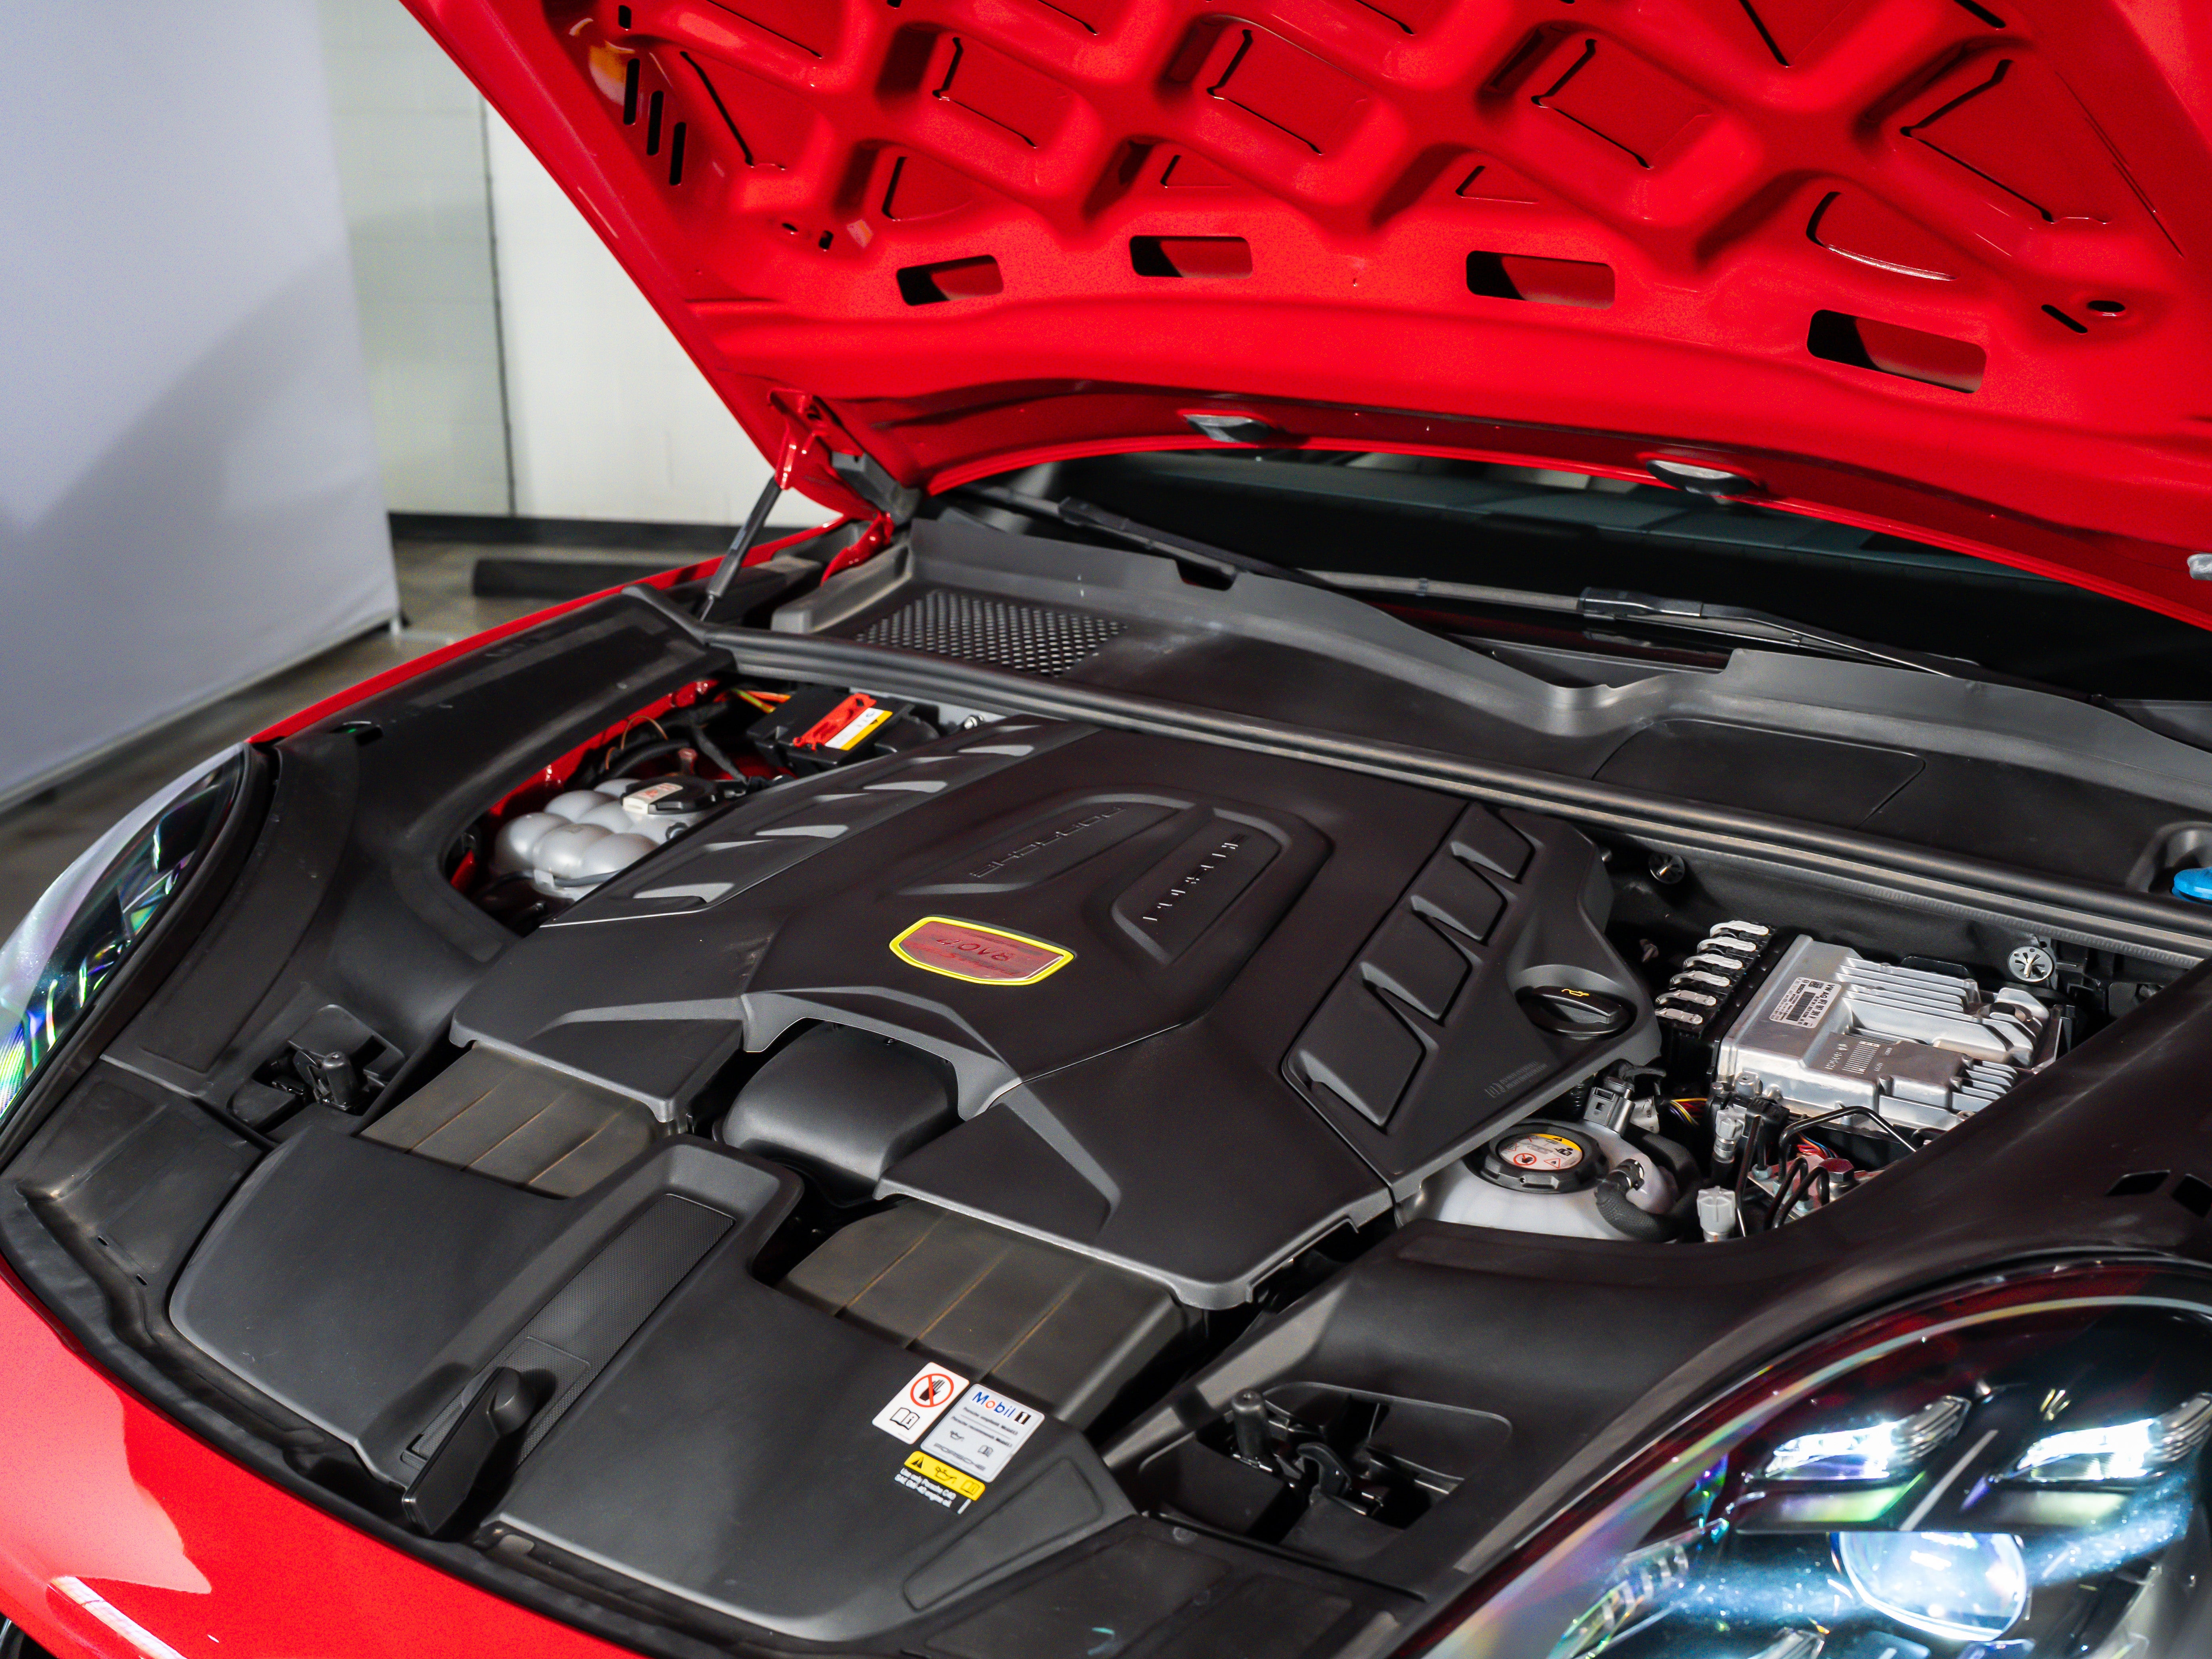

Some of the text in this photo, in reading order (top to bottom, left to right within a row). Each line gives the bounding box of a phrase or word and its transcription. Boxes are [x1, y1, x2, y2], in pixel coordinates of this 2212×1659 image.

[1795, 984, 1806, 994] BOSCH
[972, 1391, 1015, 1418] Mobil
[934, 1442, 986, 1472] PORSCHE
[921, 1478, 943, 1494] Porsche
